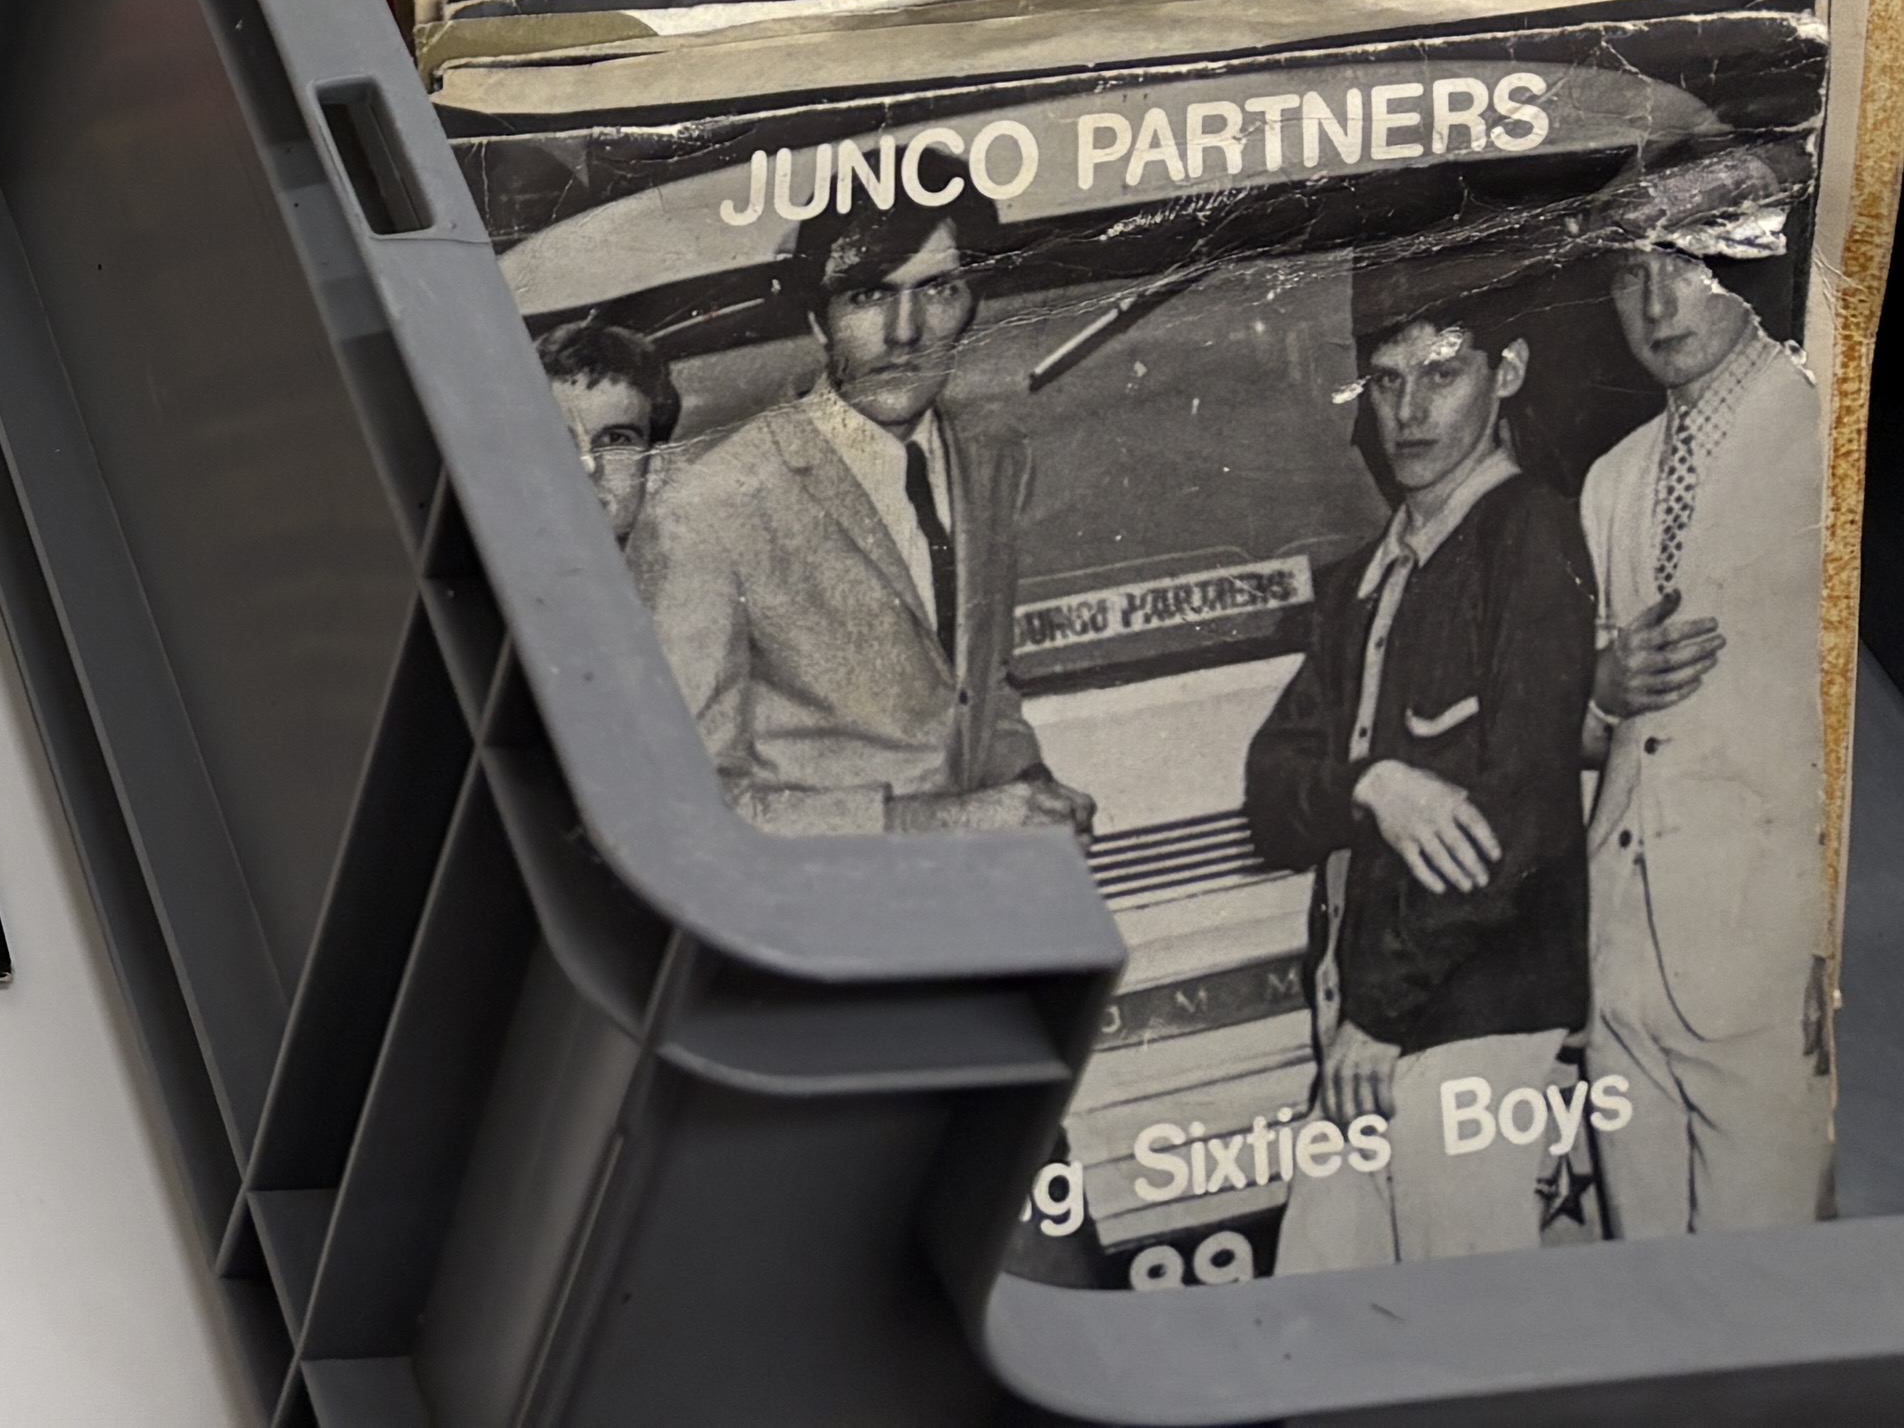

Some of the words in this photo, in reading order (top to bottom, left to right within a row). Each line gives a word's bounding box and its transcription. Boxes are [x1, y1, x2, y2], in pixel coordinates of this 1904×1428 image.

[718, 117, 1041, 228] JUNCO
[1075, 70, 1550, 191] PARTNERS
[1132, 1107, 1392, 1202] Sixties
[1440, 1074, 1634, 1157] Boys
